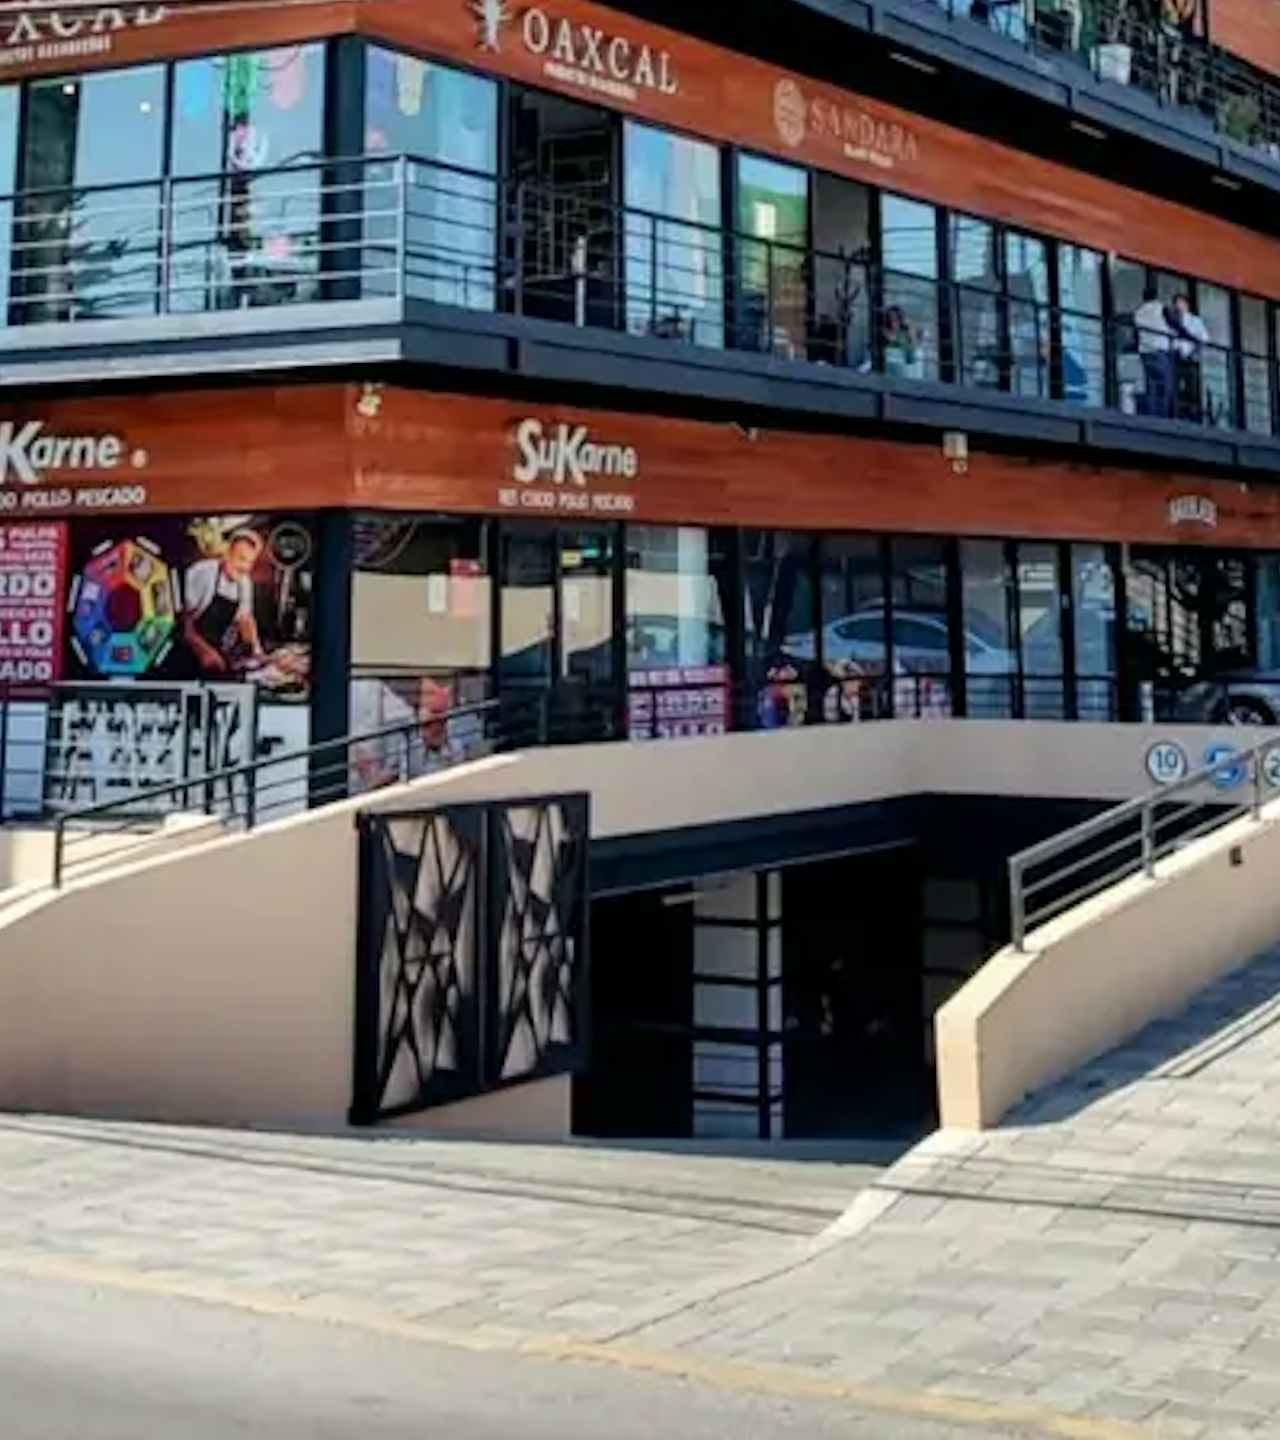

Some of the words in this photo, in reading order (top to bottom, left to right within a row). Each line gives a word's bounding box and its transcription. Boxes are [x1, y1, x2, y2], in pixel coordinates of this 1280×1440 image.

[523, 9, 679, 96] OAXCAL
[513, 417, 637, 486] SuKarne
[22, 488, 71, 508] POLLO
[75, 485, 147, 507] PESCADO
[1155, 750, 1178, 769] 10
